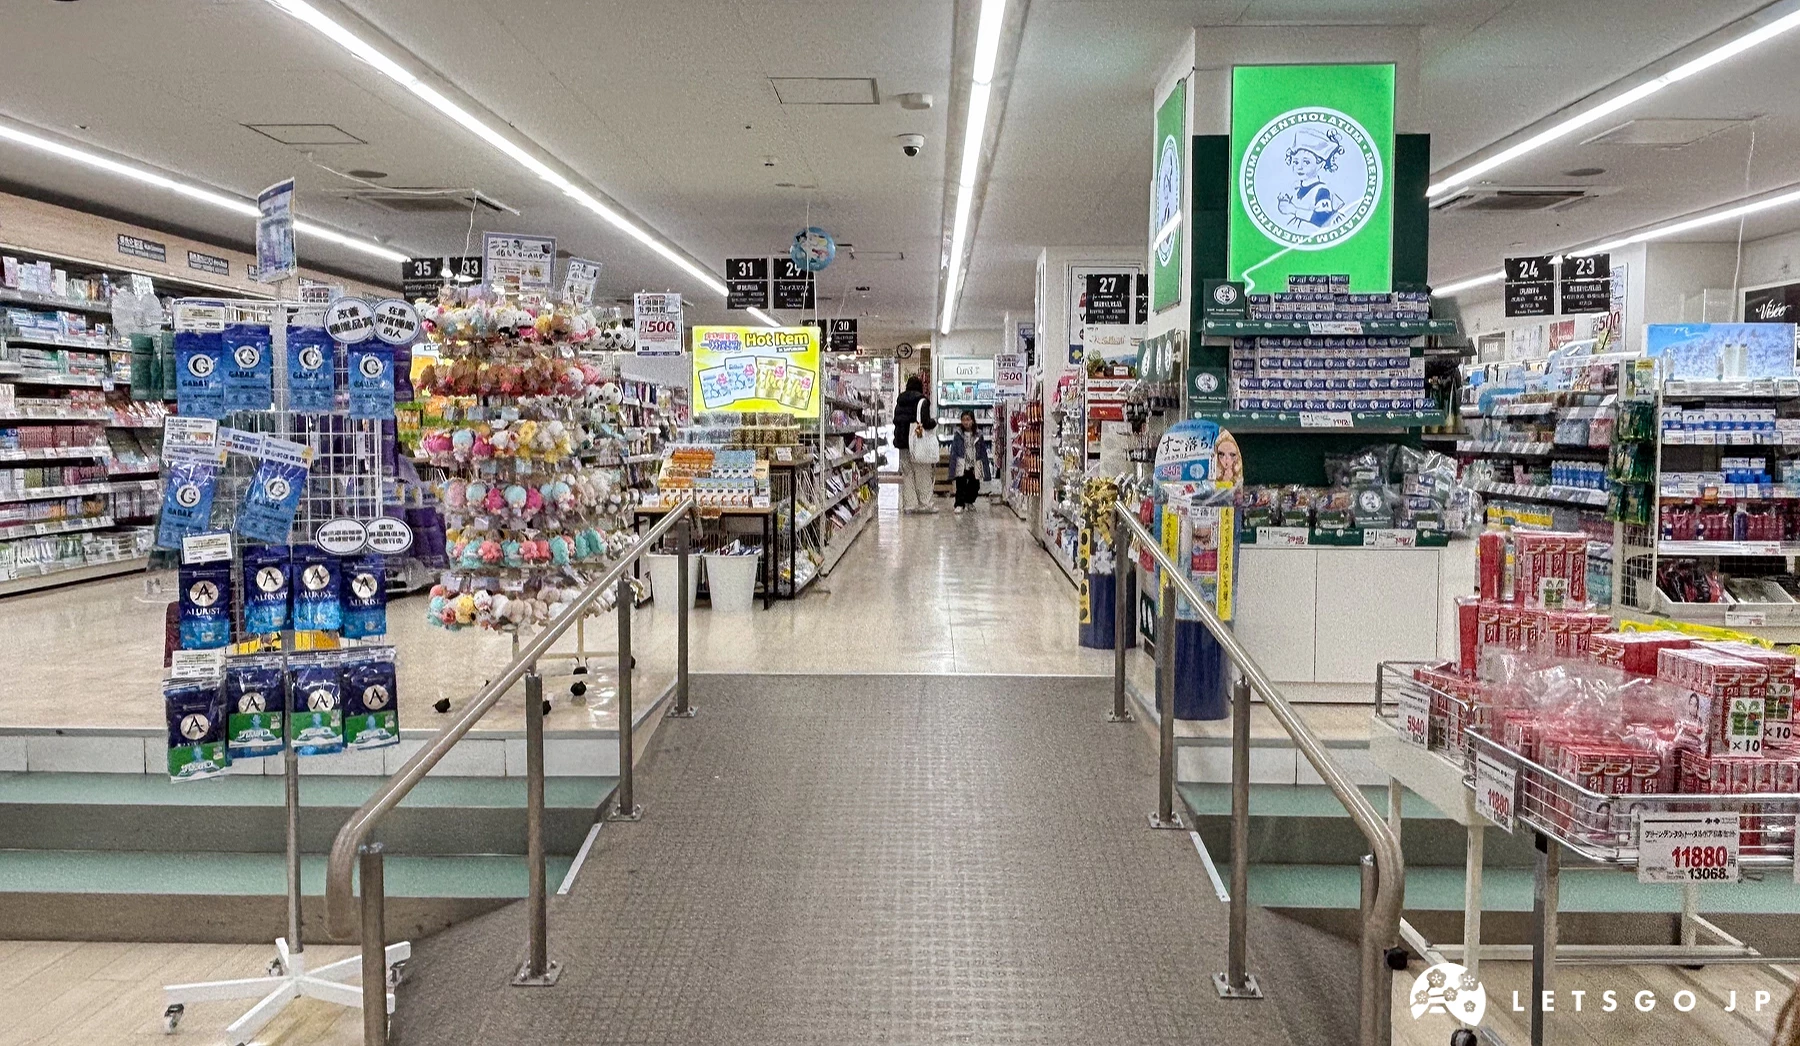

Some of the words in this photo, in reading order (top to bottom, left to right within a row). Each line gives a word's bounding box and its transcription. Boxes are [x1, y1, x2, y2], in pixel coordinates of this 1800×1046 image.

[1259, 113, 1364, 146] MENTHOLATUM
[1245, 154, 1302, 244] MENTHOLATUM
[1315, 151, 1377, 244] MENTHOLATUM
[414, 261, 431, 276] 35
[462, 260, 479, 275] 33
[738, 261, 754, 276] 31
[1519, 260, 1539, 278] 24
[1576, 258, 1595, 275] 23
[1099, 277, 1117, 293] 27
[383, 326, 401, 338] 的人
[647, 320, 676, 333] 500
[838, 321, 850, 331] 30
[745, 332, 773, 348] Hot
[774, 331, 810, 347] Item
[1004, 372, 1023, 381] 500
[263, 570, 278, 587] A
[309, 568, 328, 584] A
[195, 583, 213, 600] A
[358, 576, 374, 593] A
[244, 696, 261, 712] A
[313, 693, 329, 709] A
[369, 688, 384, 704] A
[186, 715, 205, 735] A
[1487, 787, 1509, 817] 11880
